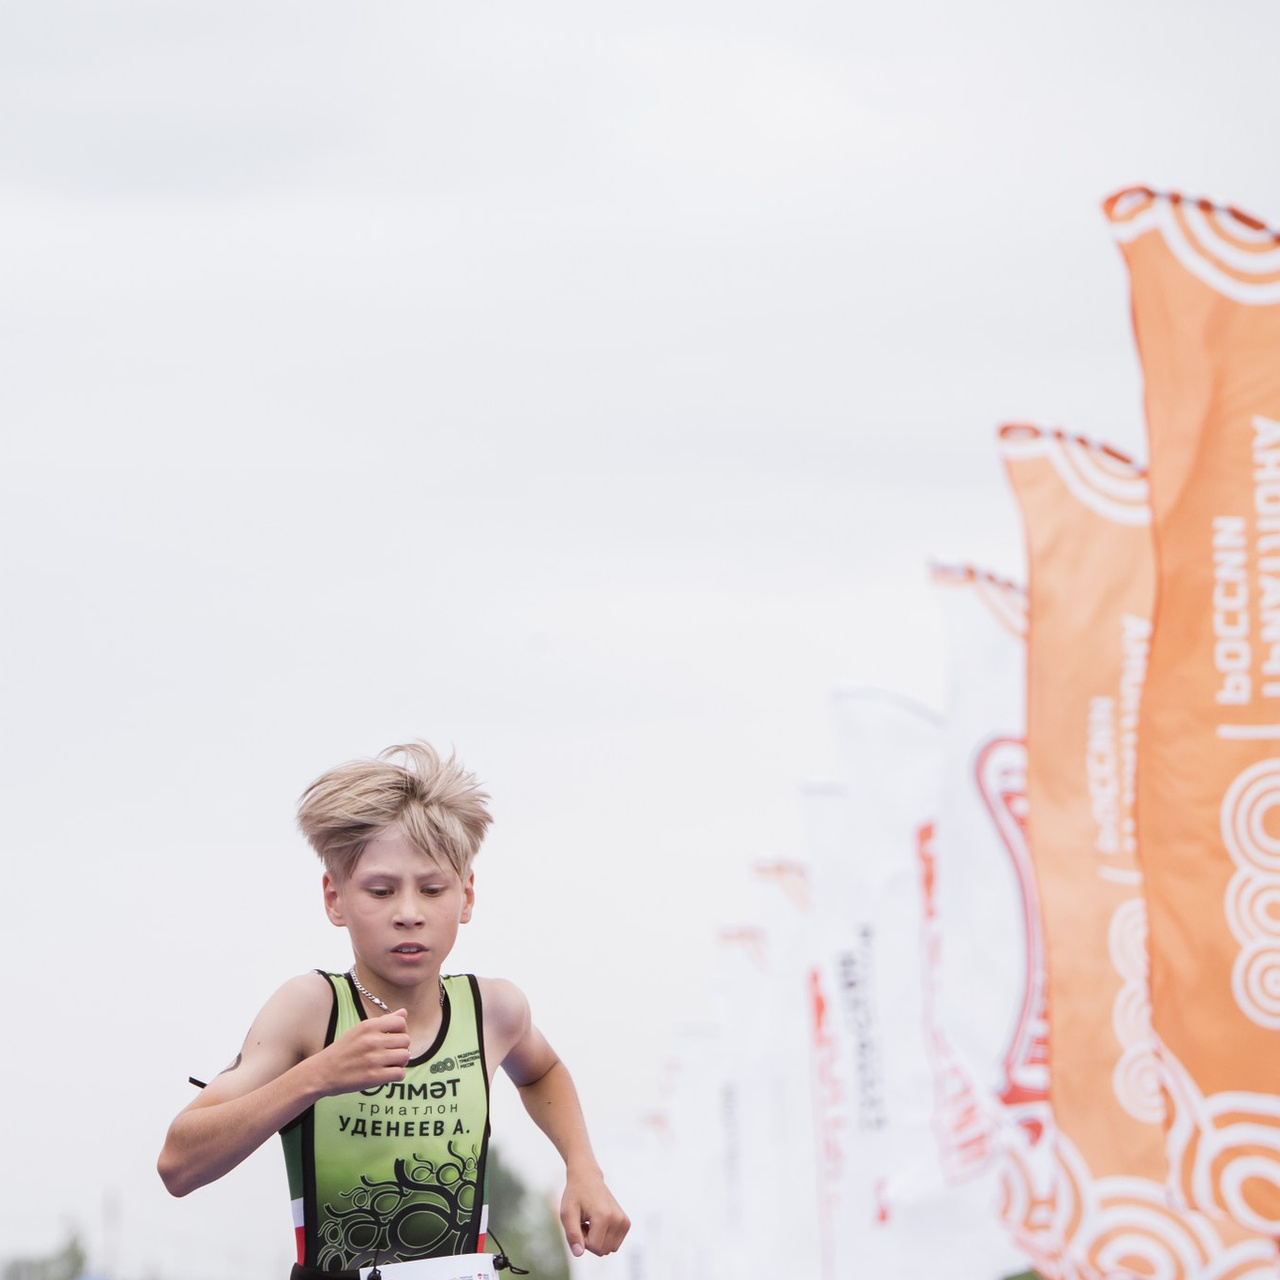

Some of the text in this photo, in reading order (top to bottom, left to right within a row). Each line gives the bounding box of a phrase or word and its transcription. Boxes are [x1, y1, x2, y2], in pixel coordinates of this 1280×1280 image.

[358, 1102, 458, 1116] триатлон
[338, 1115, 471, 1138] УДЕНЕЕВ А.
